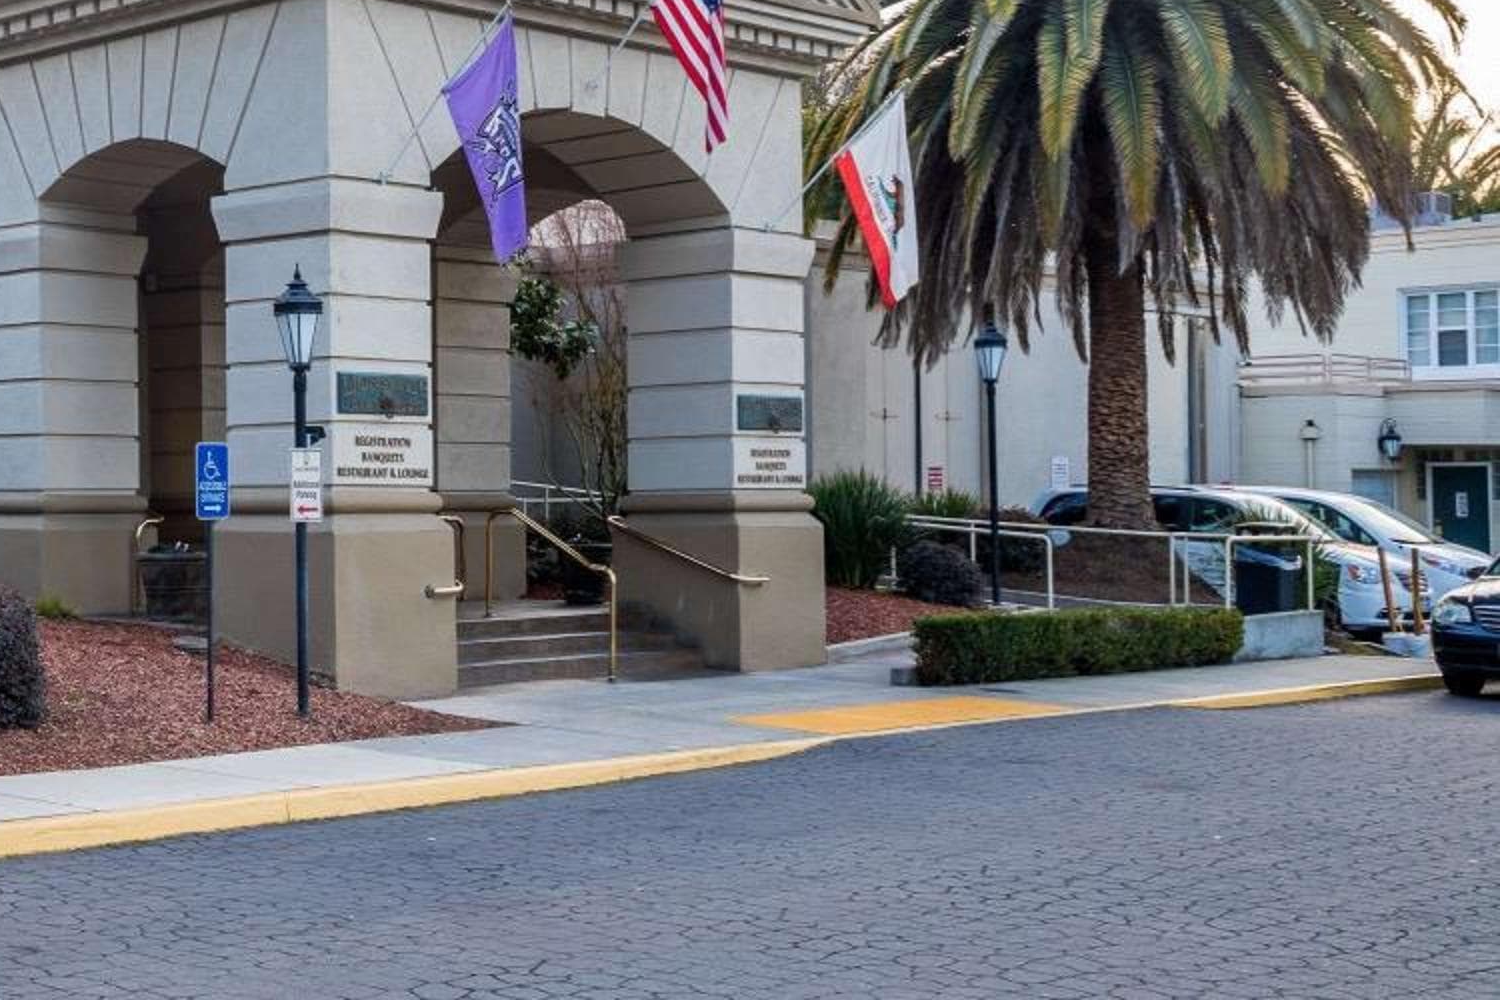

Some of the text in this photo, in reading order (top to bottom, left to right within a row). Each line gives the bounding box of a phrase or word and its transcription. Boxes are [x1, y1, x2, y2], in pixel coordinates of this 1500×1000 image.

[355, 435, 411, 448] REGISTRATION
[361, 452, 405, 463] BANQUETS
[337, 467, 388, 478] RESTAURANT
[398, 468, 429, 479] LOUNGE
